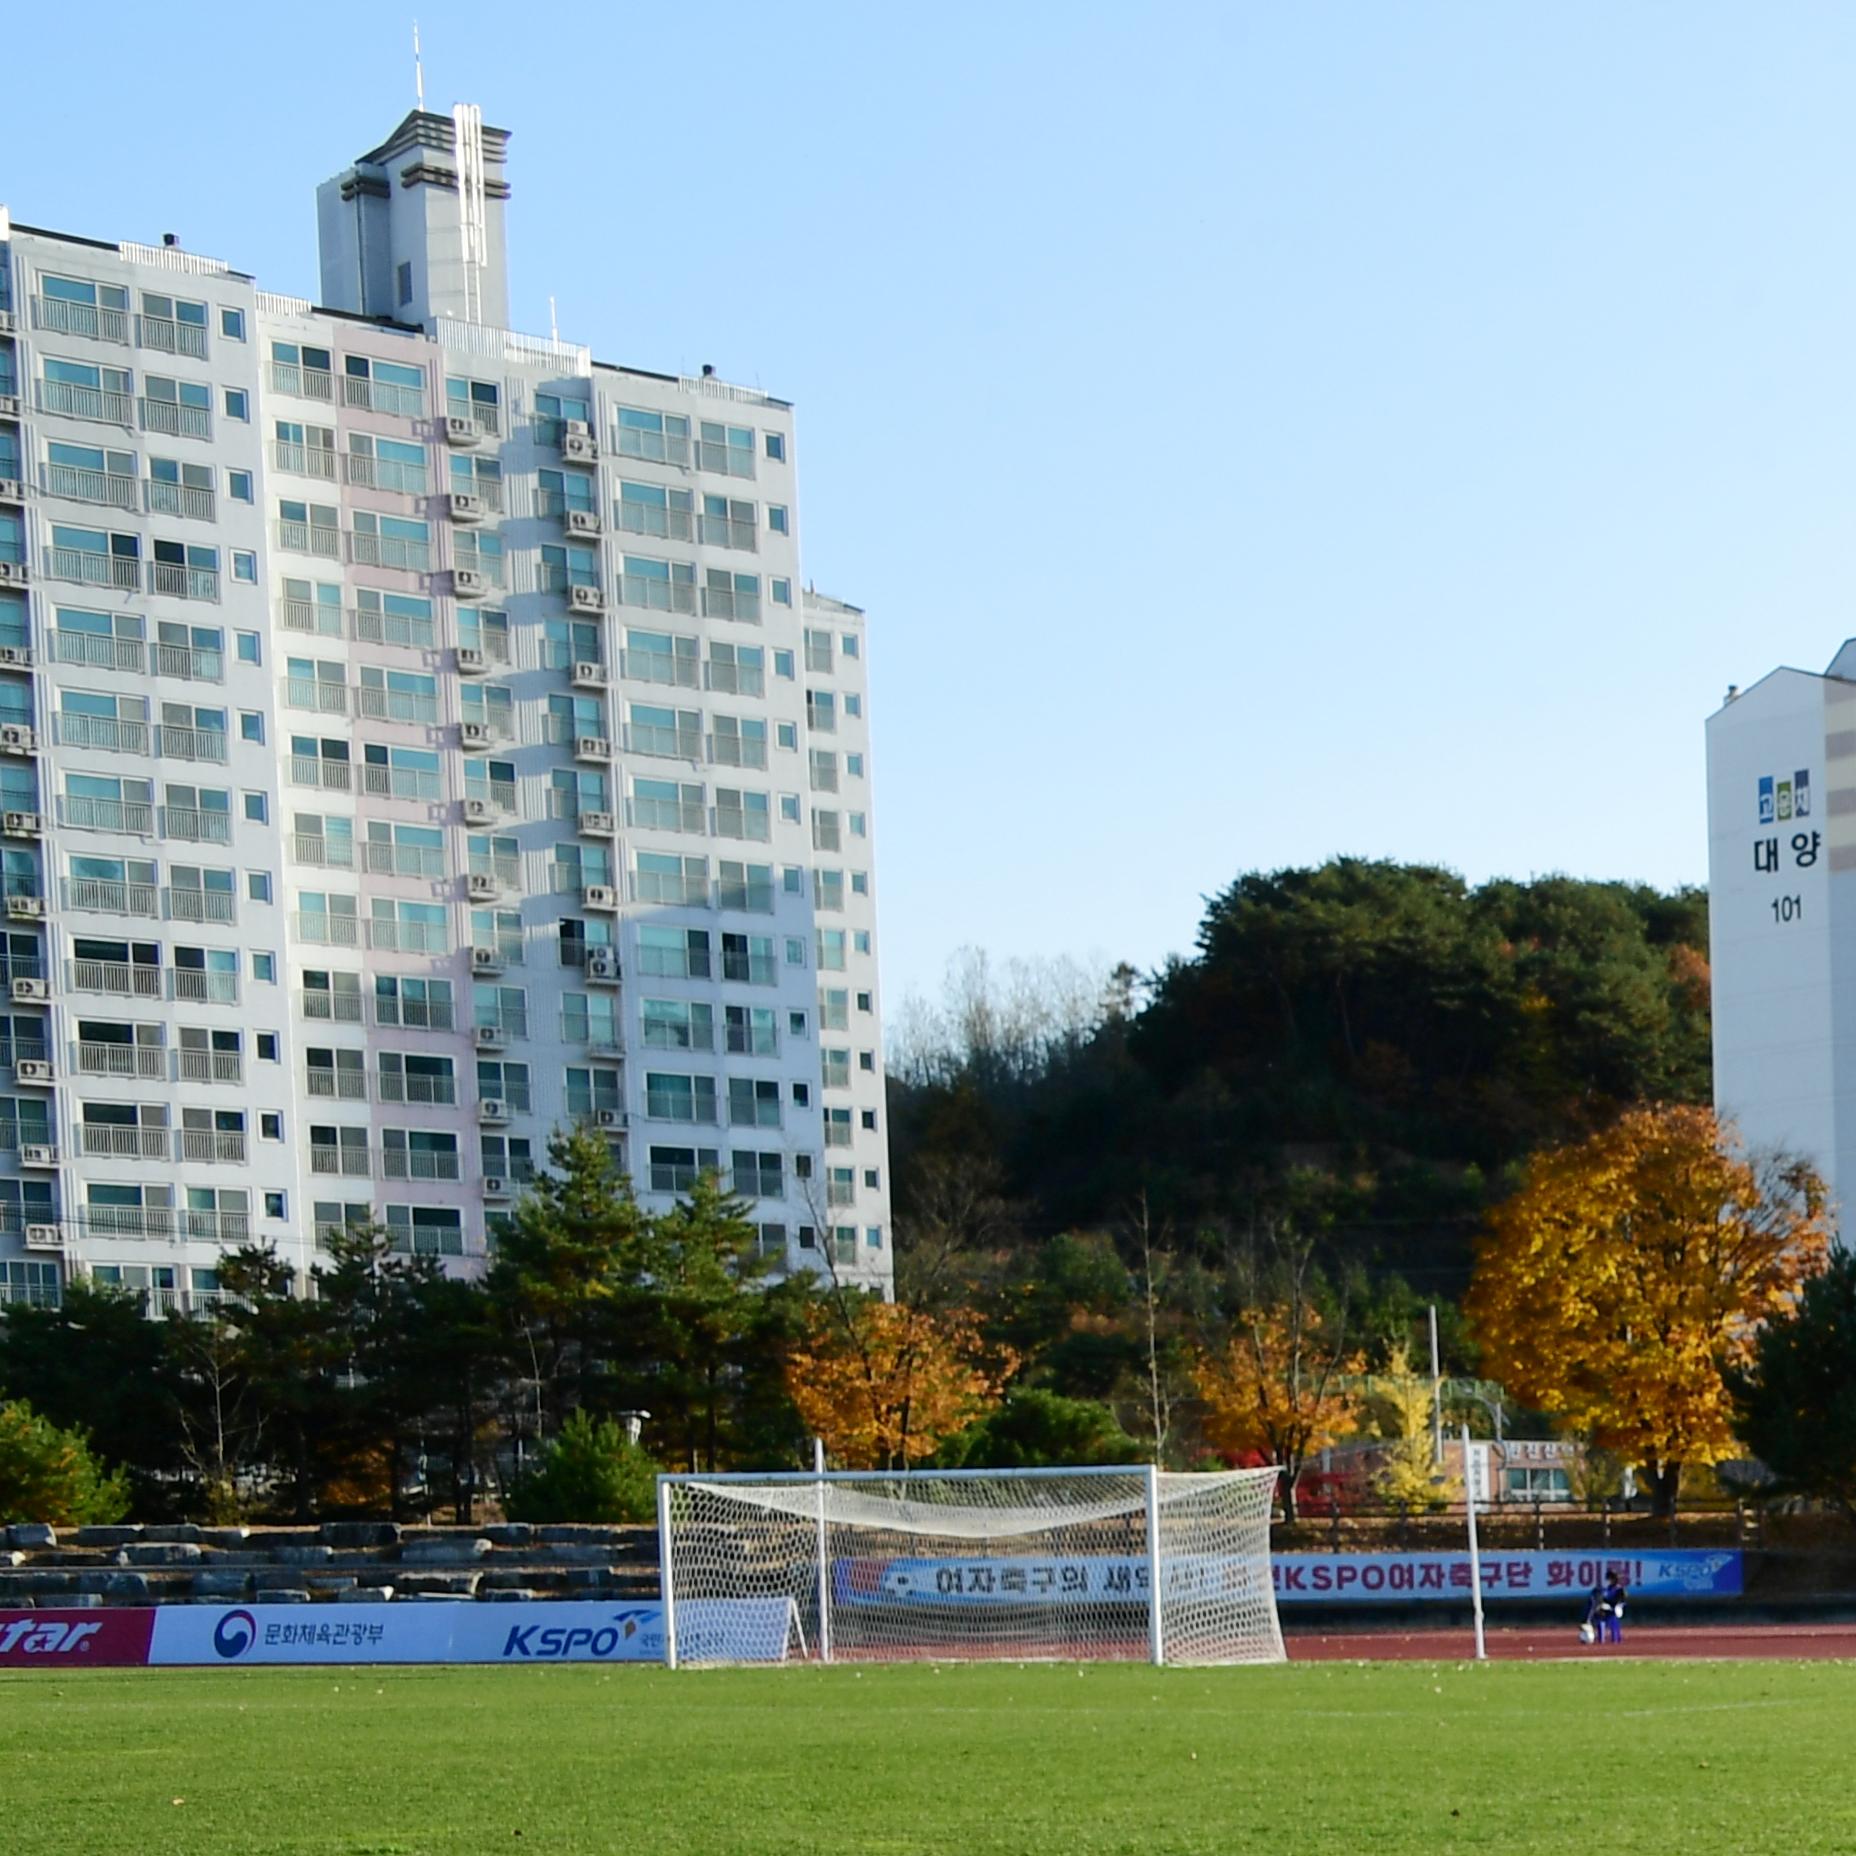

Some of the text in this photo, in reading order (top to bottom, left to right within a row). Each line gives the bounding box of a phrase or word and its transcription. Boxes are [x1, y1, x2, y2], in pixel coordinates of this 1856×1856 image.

[1771, 894, 1802, 923] 101
[0, 1619, 103, 1653] tar
[264, 1623, 384, 1646] 문화체육관광부
[503, 1625, 618, 1657] KSPO
